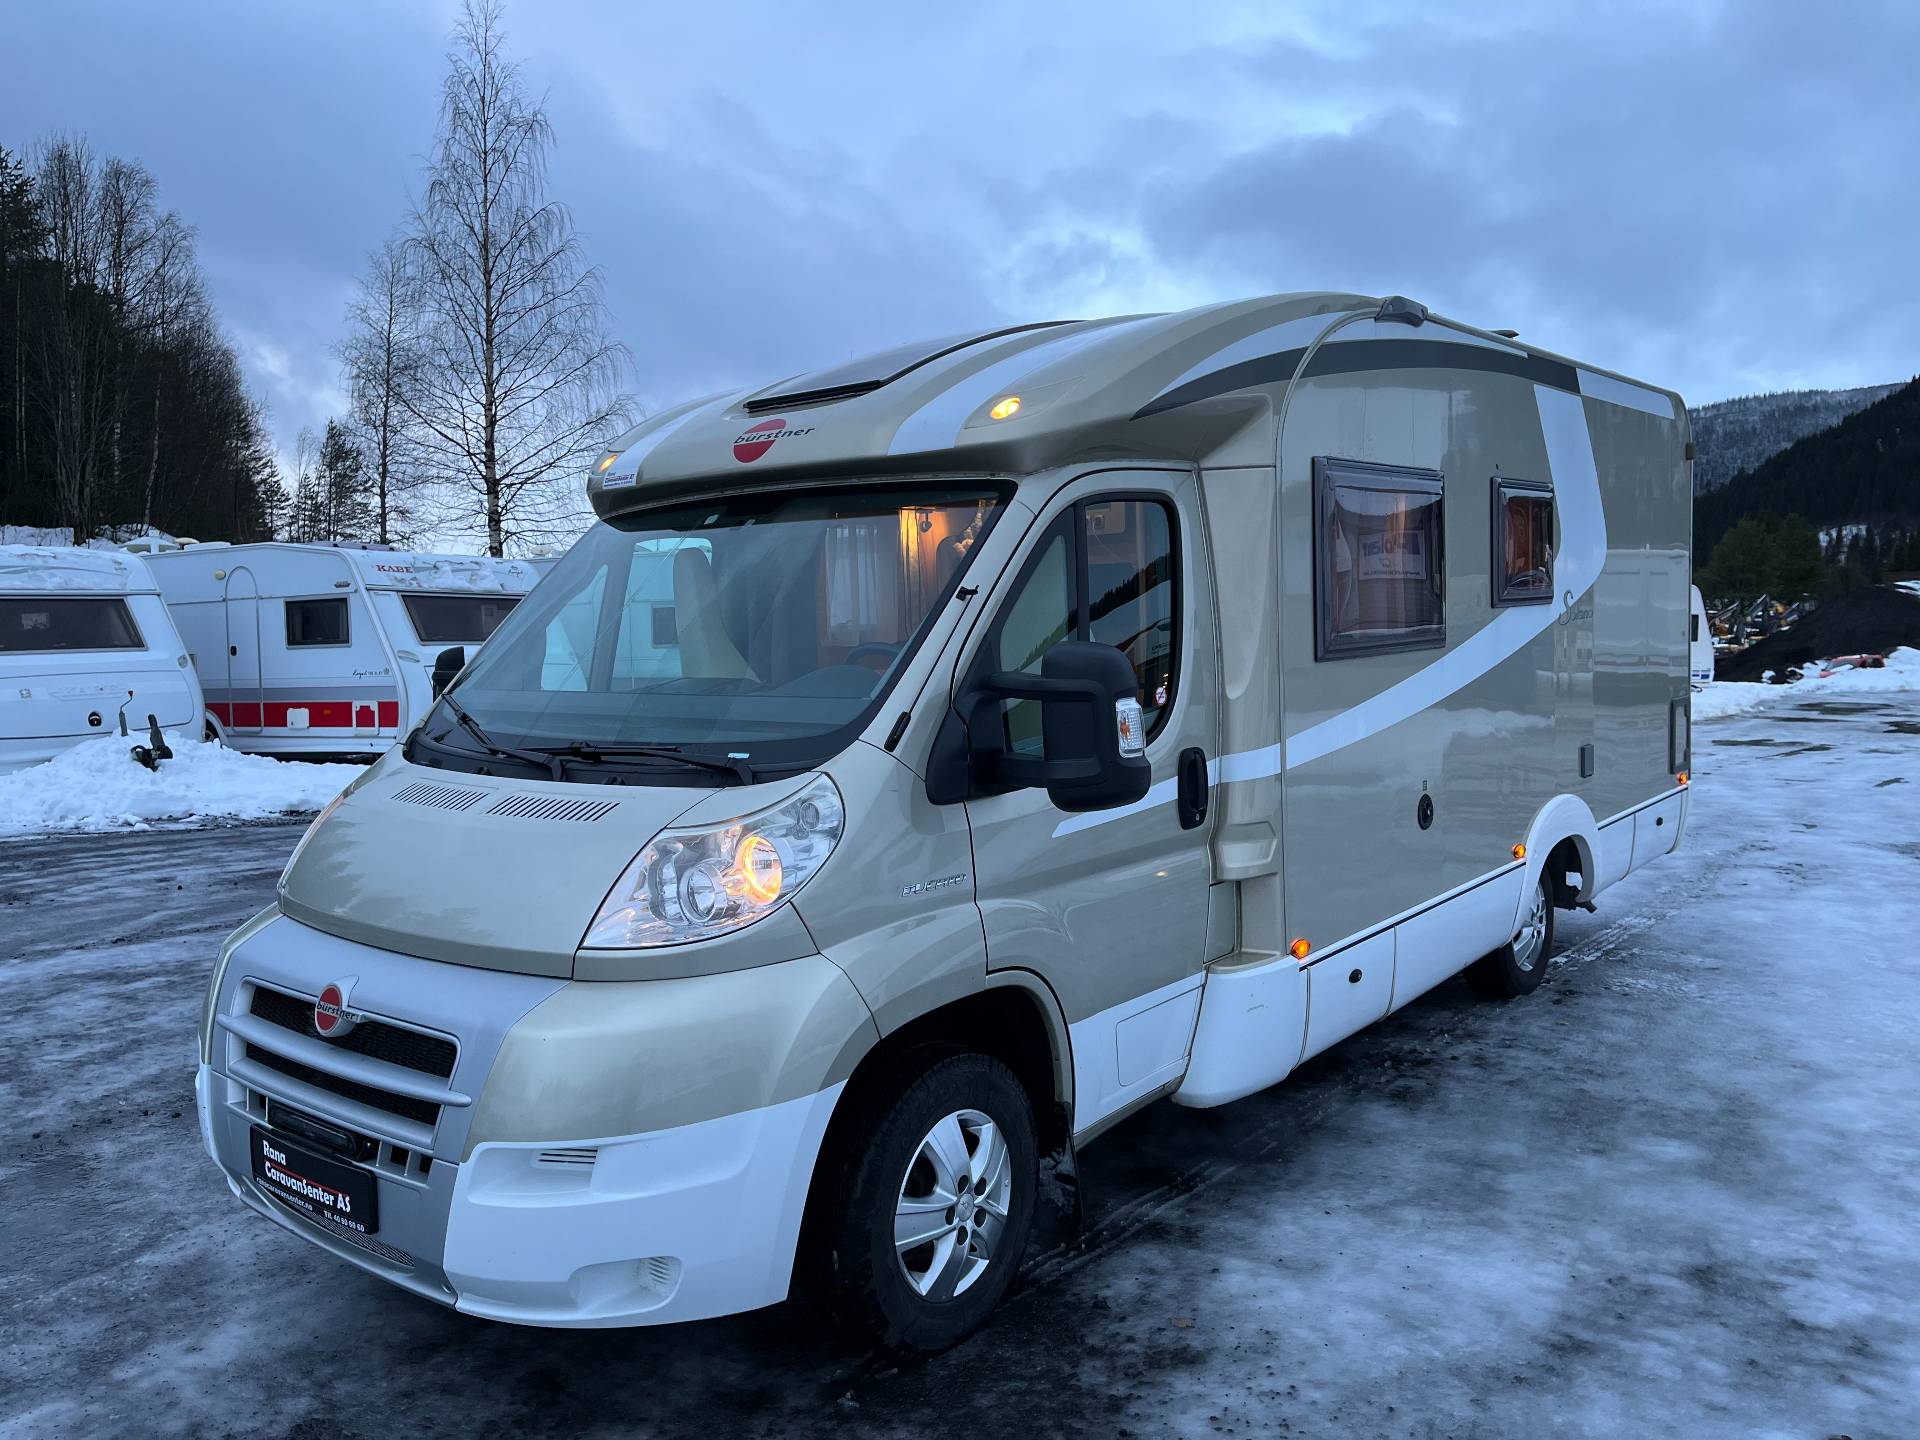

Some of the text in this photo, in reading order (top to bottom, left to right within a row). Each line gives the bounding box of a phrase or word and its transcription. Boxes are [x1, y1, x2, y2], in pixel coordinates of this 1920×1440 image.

[733, 427, 815, 445] bürstner
[375, 564, 413, 574] KABE
[316, 1000, 356, 1020] bürstner
[262, 1139, 287, 1166] Rana
[264, 1161, 351, 1213] CaravanSenter AS
